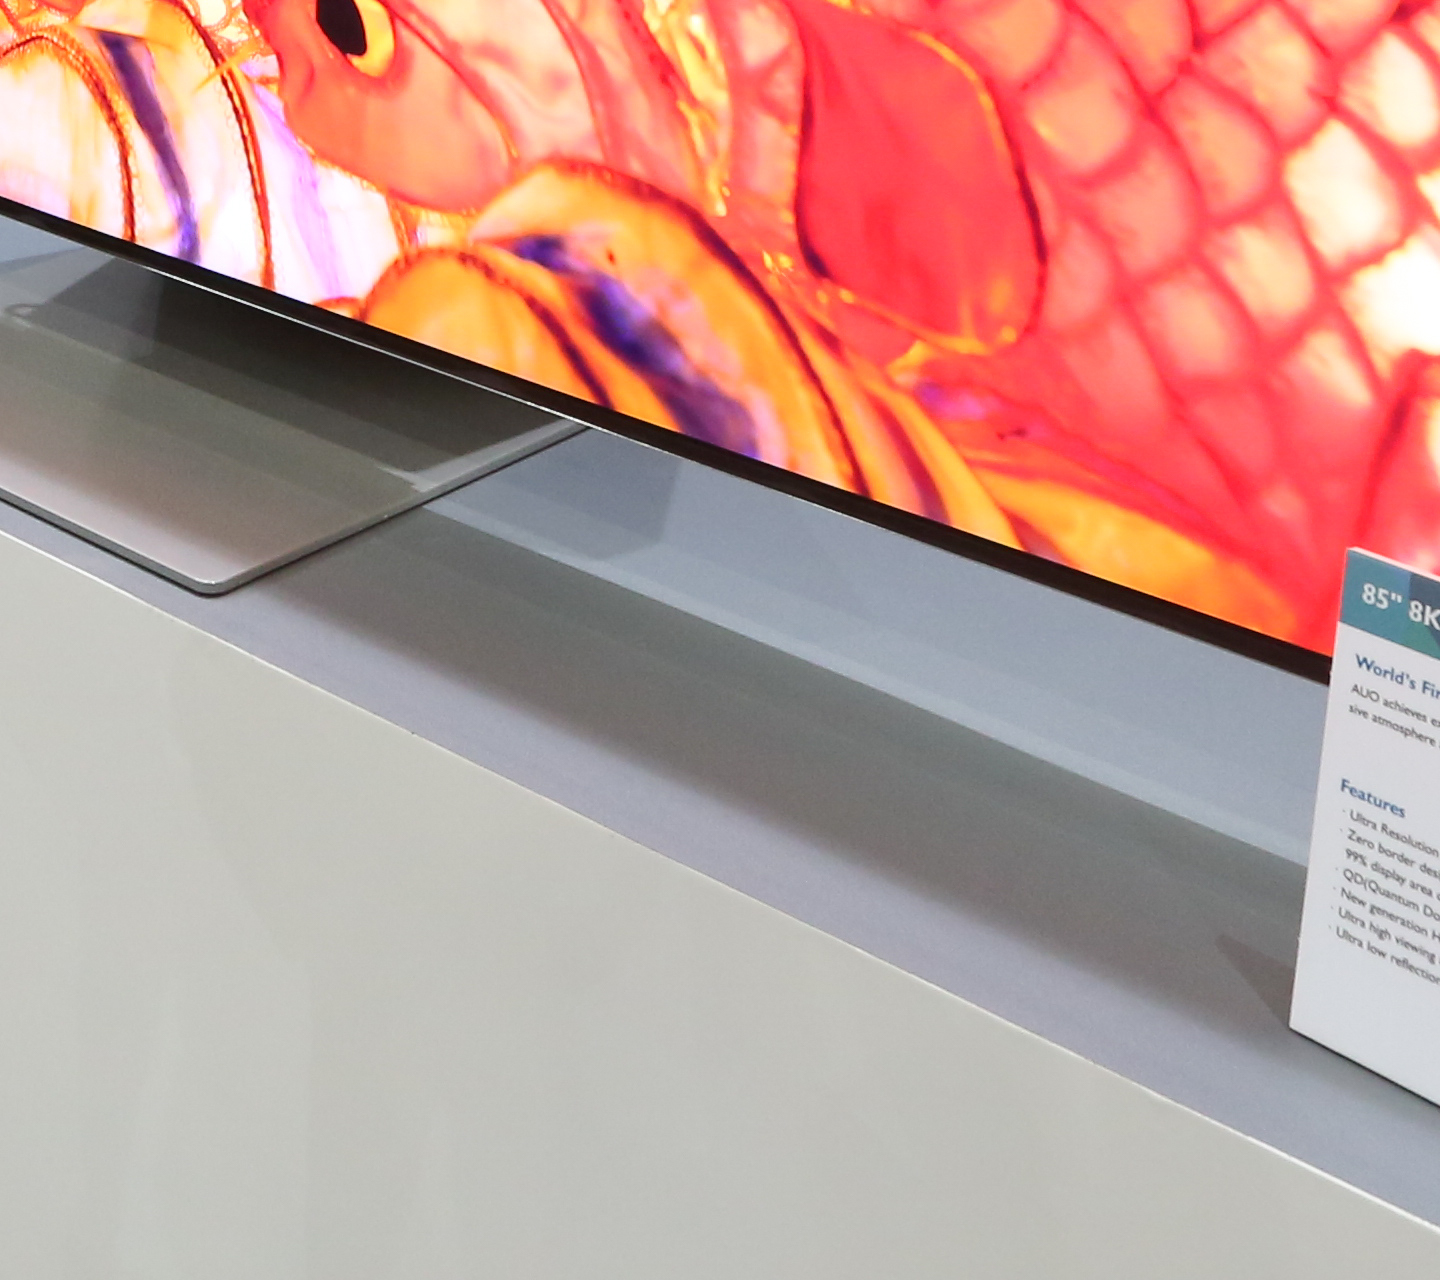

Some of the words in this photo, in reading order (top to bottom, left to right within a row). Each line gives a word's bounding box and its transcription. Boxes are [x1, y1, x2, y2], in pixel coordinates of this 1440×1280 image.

[1355, 653, 1416, 690] World's
[1351, 684, 1380, 703] AUO
[1383, 698, 1428, 723] achieves
[1348, 703, 1368, 719] sive
[1372, 714, 1436, 748] atmosphere
[1340, 778, 1406, 819] Features
[1347, 829, 1375, 851] Zero
[1378, 842, 1416, 868] border
[1349, 809, 1377, 831] Ultra
[1381, 823, 1439, 859] Resolution
[1345, 848, 1368, 868] 99%
[1371, 860, 1406, 887] display
[1409, 879, 1433, 899] area
[1340, 887, 1367, 909] New
[1369, 903, 1428, 938] generation
[1336, 925, 1364, 950] Ultra
[1366, 941, 1387, 959] low
[1338, 906, 1365, 929] Ultra
[1369, 921, 1392, 942] high
[1395, 934, 1436, 965] viewing
